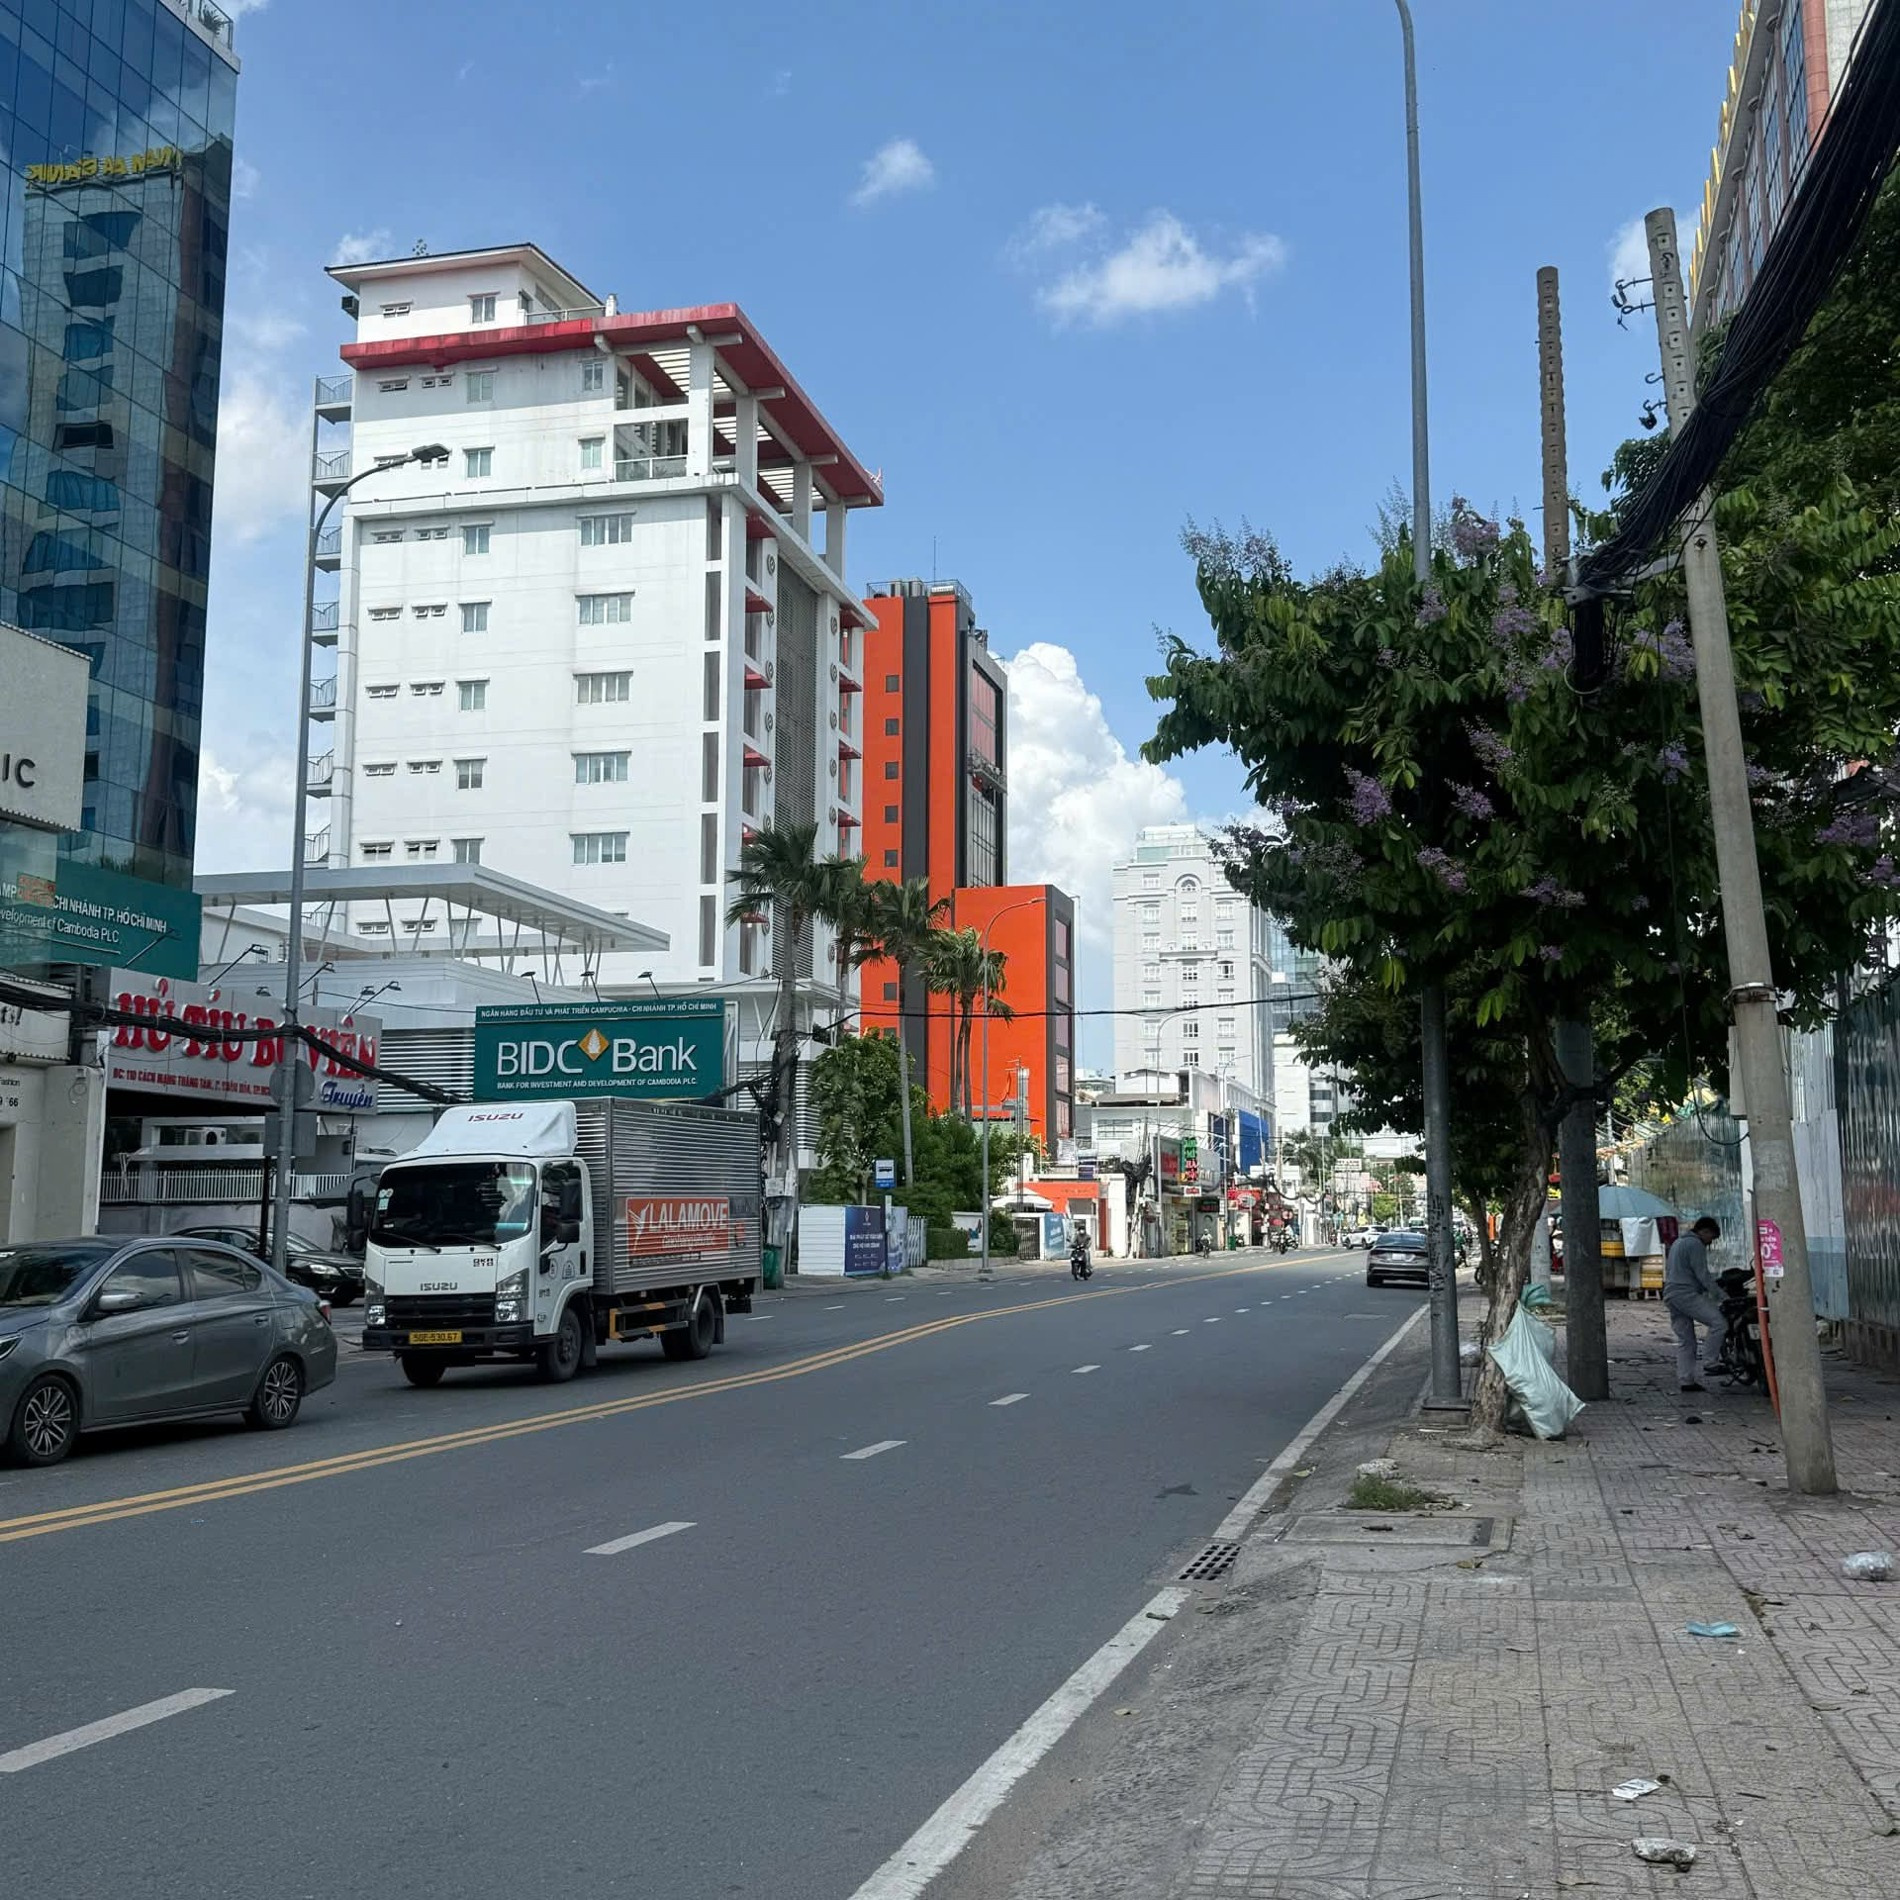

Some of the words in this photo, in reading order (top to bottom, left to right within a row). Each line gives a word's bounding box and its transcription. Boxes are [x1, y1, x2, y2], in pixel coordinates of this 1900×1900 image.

[0, 907, 46, 930] velopment
[57, 918, 99, 939] Cambodia
[53, 894, 68, 911] CHI
[145, 917, 167, 933] MINH
[481, 1008, 499, 1017] NGÂN
[590, 1005, 628, 1014] CAMPUCHIA
[700, 1002, 717, 1010] MINH
[497, 1039, 583, 1075] BIDC
[612, 1036, 698, 1073] Bank
[497, 1081, 514, 1089] BANK
[516, 1080, 529, 1089] FOR
[530, 1080, 572, 1089] INVESTMENT
[588, 1079, 636, 1087] DEVELOPMENT
[647, 1078, 681, 1086] CAMBODIA
[468, 1112, 524, 1122] ISUZU
[649, 1203, 728, 1232] LALAMOVE
[420, 1282, 458, 1291] ISUZU
